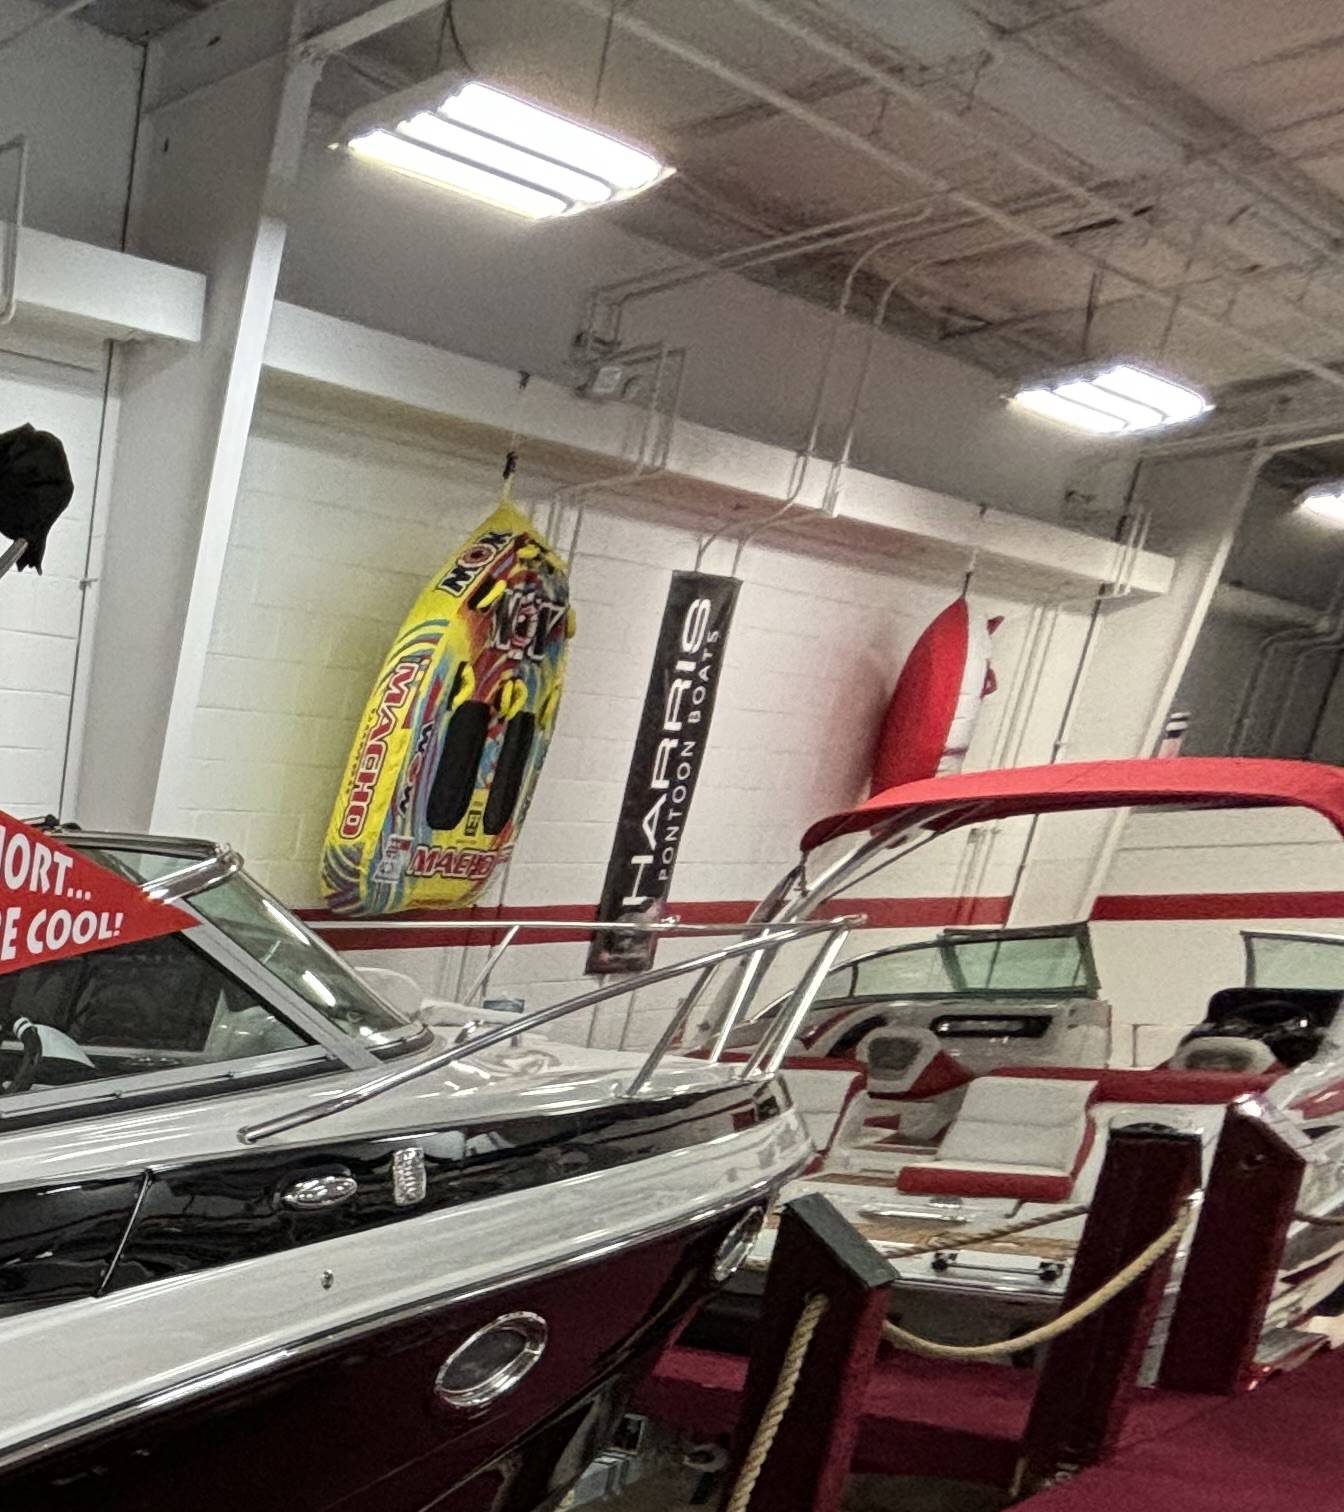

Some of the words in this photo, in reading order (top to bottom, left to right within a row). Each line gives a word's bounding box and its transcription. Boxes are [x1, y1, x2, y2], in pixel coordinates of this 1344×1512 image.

[436, 530, 514, 598] WOW
[340, 661, 420, 838] MACHO
[622, 598, 712, 906] HARRIS
[657, 740, 696, 881] PONTOON
[688, 630, 720, 724] BOATS
[26, 908, 124, 955] COOL!
